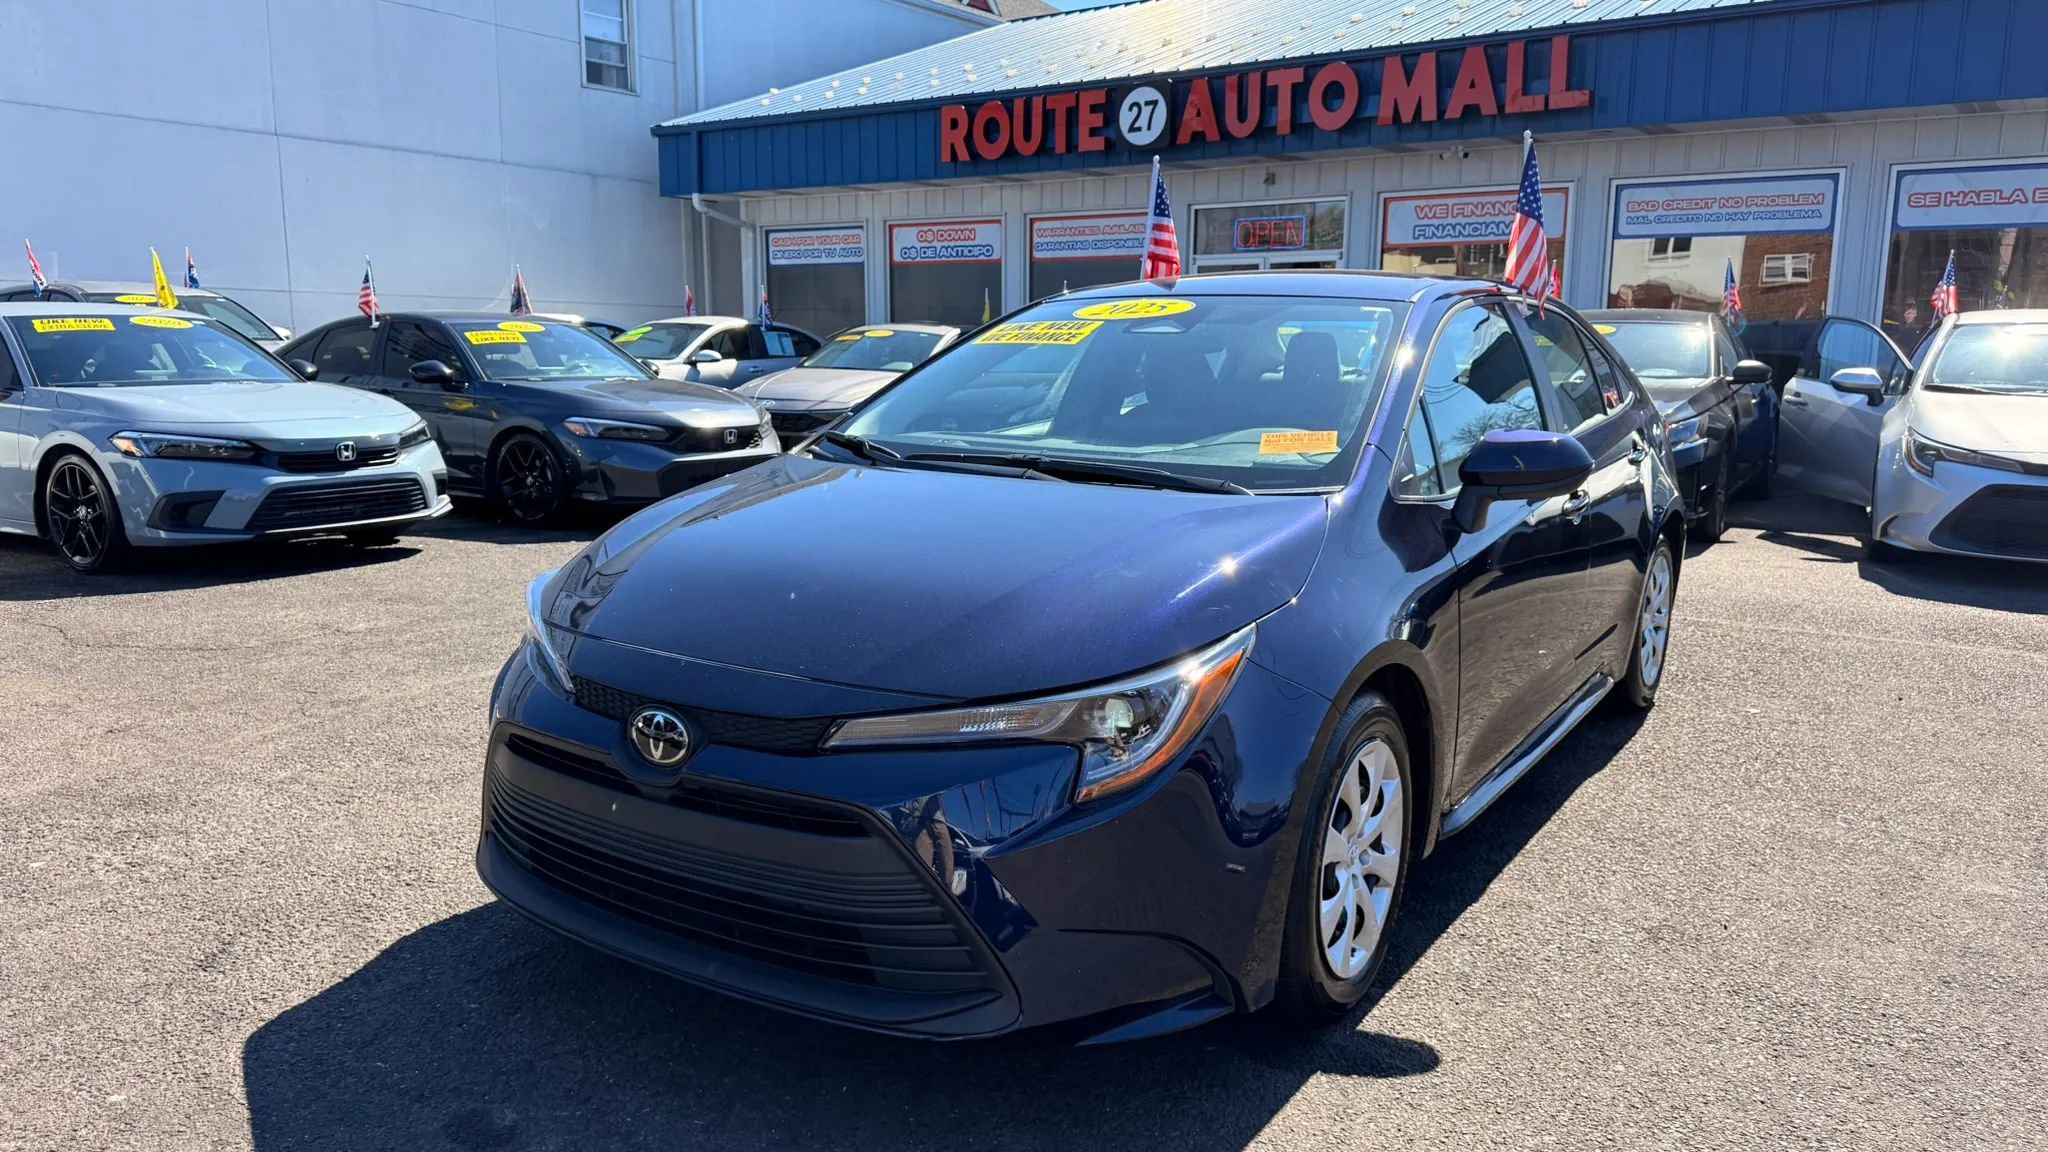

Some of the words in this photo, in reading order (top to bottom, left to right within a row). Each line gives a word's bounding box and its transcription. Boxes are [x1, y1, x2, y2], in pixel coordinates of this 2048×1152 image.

[941, 88, 1107, 163] ROUTE
[1127, 99, 1159, 133] 27
[1176, 61, 1359, 145] AUTO
[1376, 34, 1591, 126] MALL
[1627, 201, 1659, 212] BAD
[1662, 198, 1717, 211] CREDIT
[1719, 196, 1744, 208] NO
[1746, 193, 1824, 207] PROBLEM
[1908, 192, 1941, 208] SE
[1944, 188, 2028, 206] HABLA
[1415, 204, 1449, 219] WE
[1452, 200, 1519, 219] FINANC
[1626, 216, 1652, 225] MAL
[1704, 213, 1723, 222] NO
[1725, 211, 1752, 221] HAY
[1753, 209, 1822, 220] PROBLEMA
[936, 227, 976, 242] DOWN
[1036, 225, 1100, 238] WARRANTIES
[1238, 221, 1302, 247] OPEN
[1413, 221, 1515, 240] FINANCIAM
[797, 236, 815, 247] FOR
[816, 235, 840, 246] YOUR
[842, 234, 861, 245] CAR
[1035, 241, 1089, 252] GARANTIAS
[772, 249, 802, 259] DINERO
[804, 248, 822, 259] POR
[823, 248, 837, 258] TU
[838, 247, 864, 257] AUTO
[920, 245, 937, 259] DE
[938, 244, 994, 259] ANTICIPO
[1005, 331, 1084, 342] FINANCE
